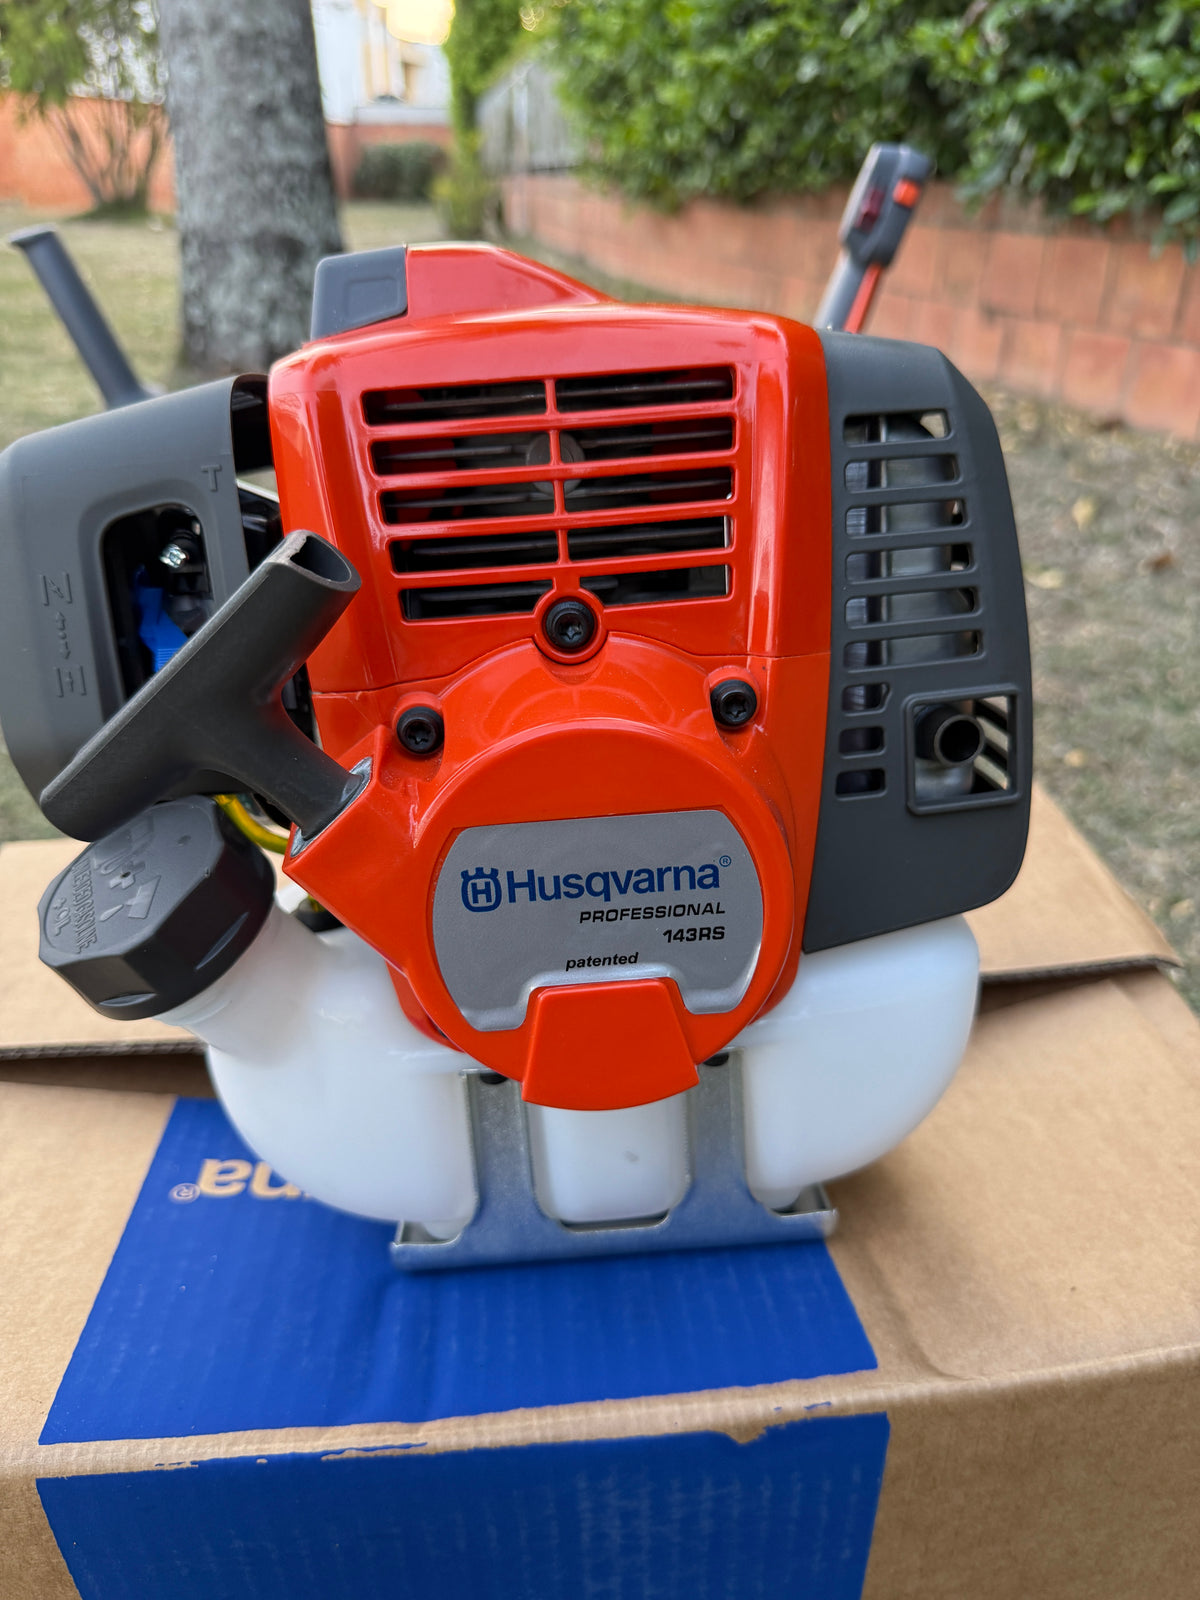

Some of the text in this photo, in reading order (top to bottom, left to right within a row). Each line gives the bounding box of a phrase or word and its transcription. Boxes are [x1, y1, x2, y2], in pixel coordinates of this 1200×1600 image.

[579, 902, 726, 924] PROFESSIONAL
[663, 926, 726, 944] 143RS
[565, 952, 639, 972] patented
